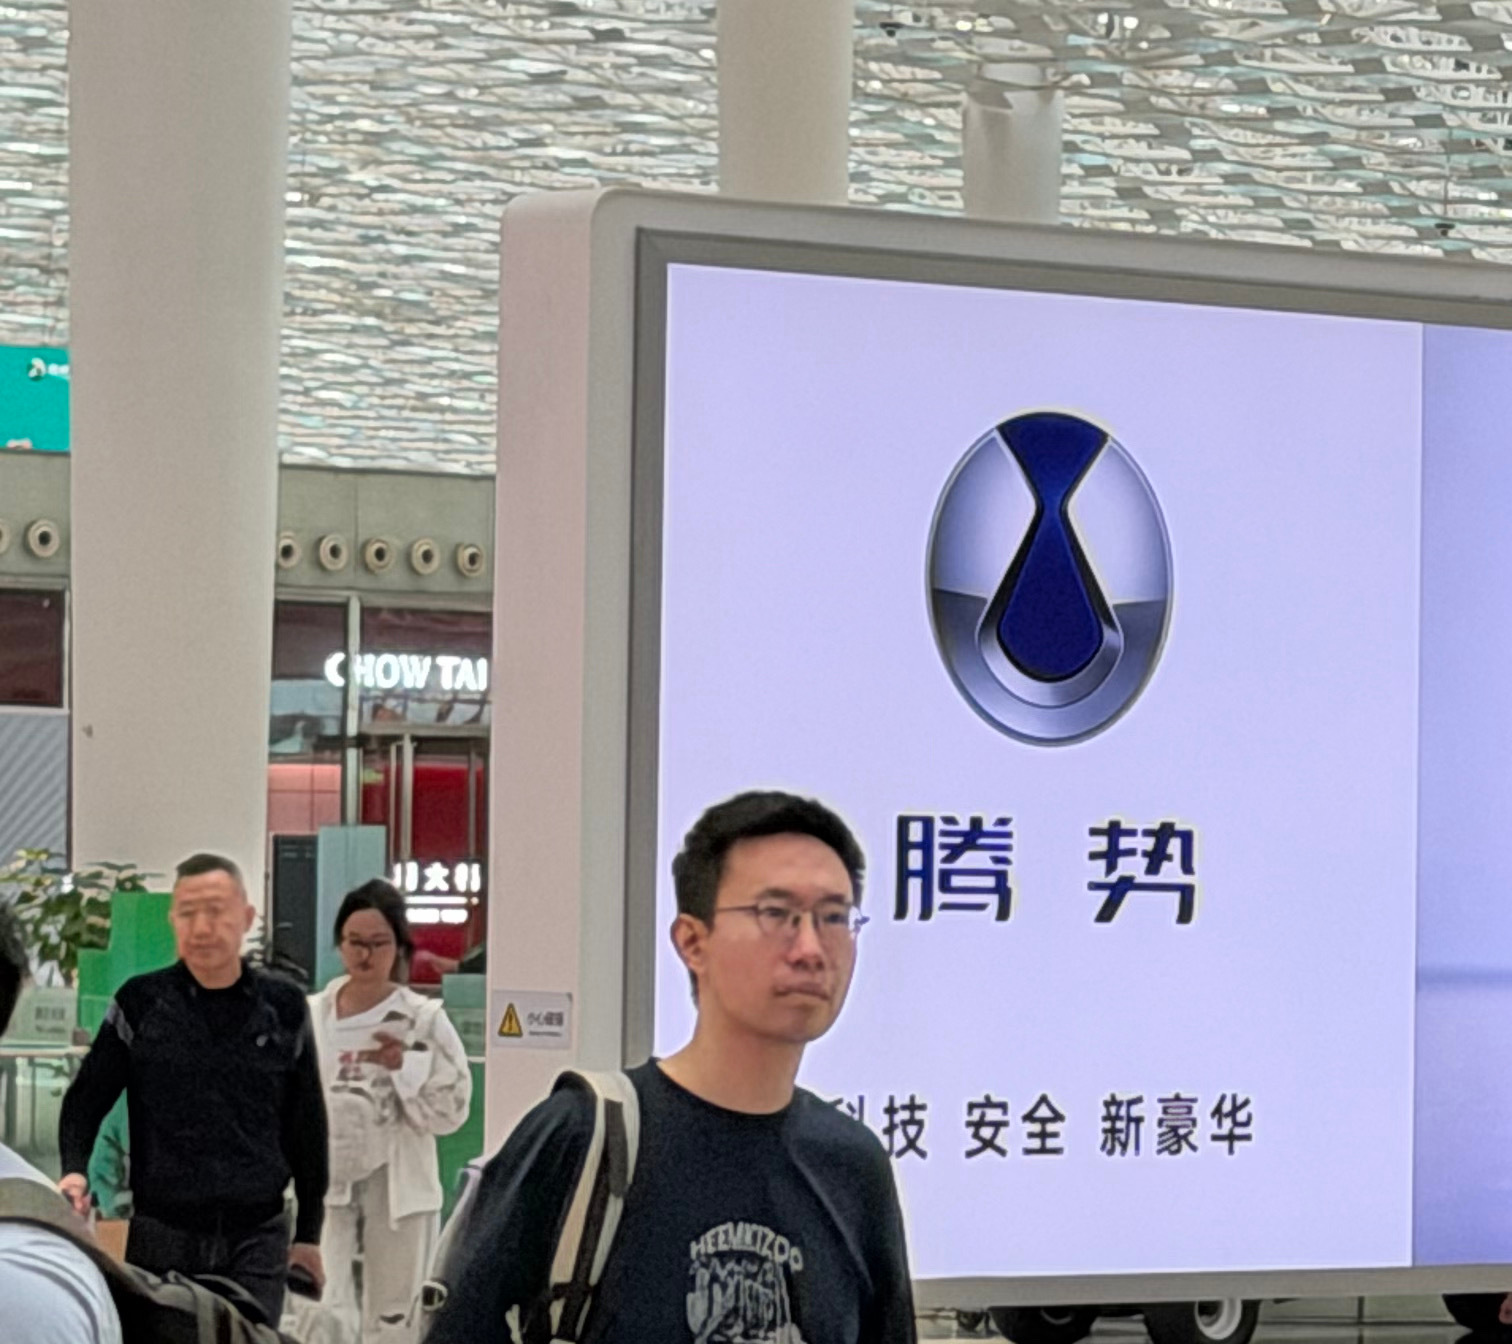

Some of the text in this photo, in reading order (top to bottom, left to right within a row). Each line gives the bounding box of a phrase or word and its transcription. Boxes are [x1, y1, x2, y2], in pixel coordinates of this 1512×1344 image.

[324, 652, 488, 692] CHOW TAI
[964, 1093, 1067, 1158] 安全
[1099, 1092, 1254, 1157] 新豪华
